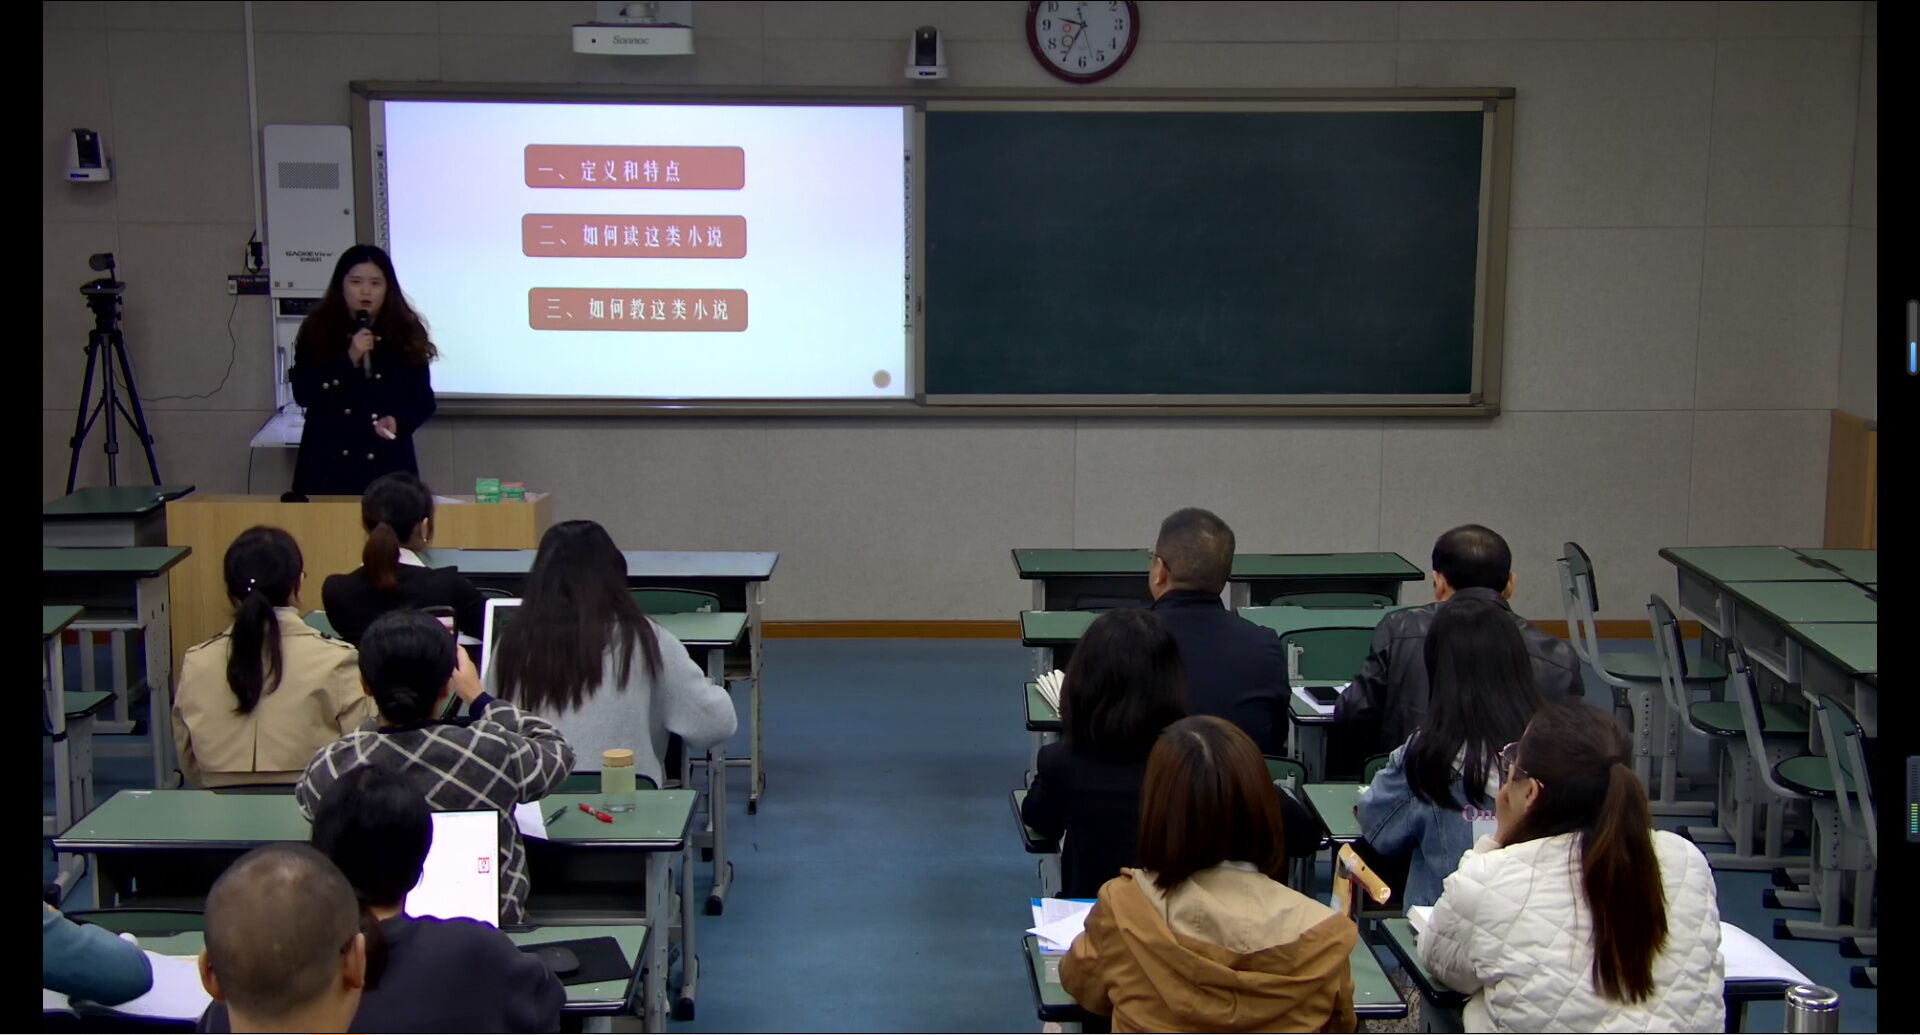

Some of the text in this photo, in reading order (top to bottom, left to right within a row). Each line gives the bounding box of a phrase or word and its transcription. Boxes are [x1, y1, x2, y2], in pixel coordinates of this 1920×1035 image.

[1042, 19, 1051, 31] 9
[1114, 18, 1123, 31] 3
[1048, 37, 1057, 49] 8
[1060, 50, 1069, 62] 7
[1078, 55, 1087, 68] 6
[1096, 50, 1105, 62] 5
